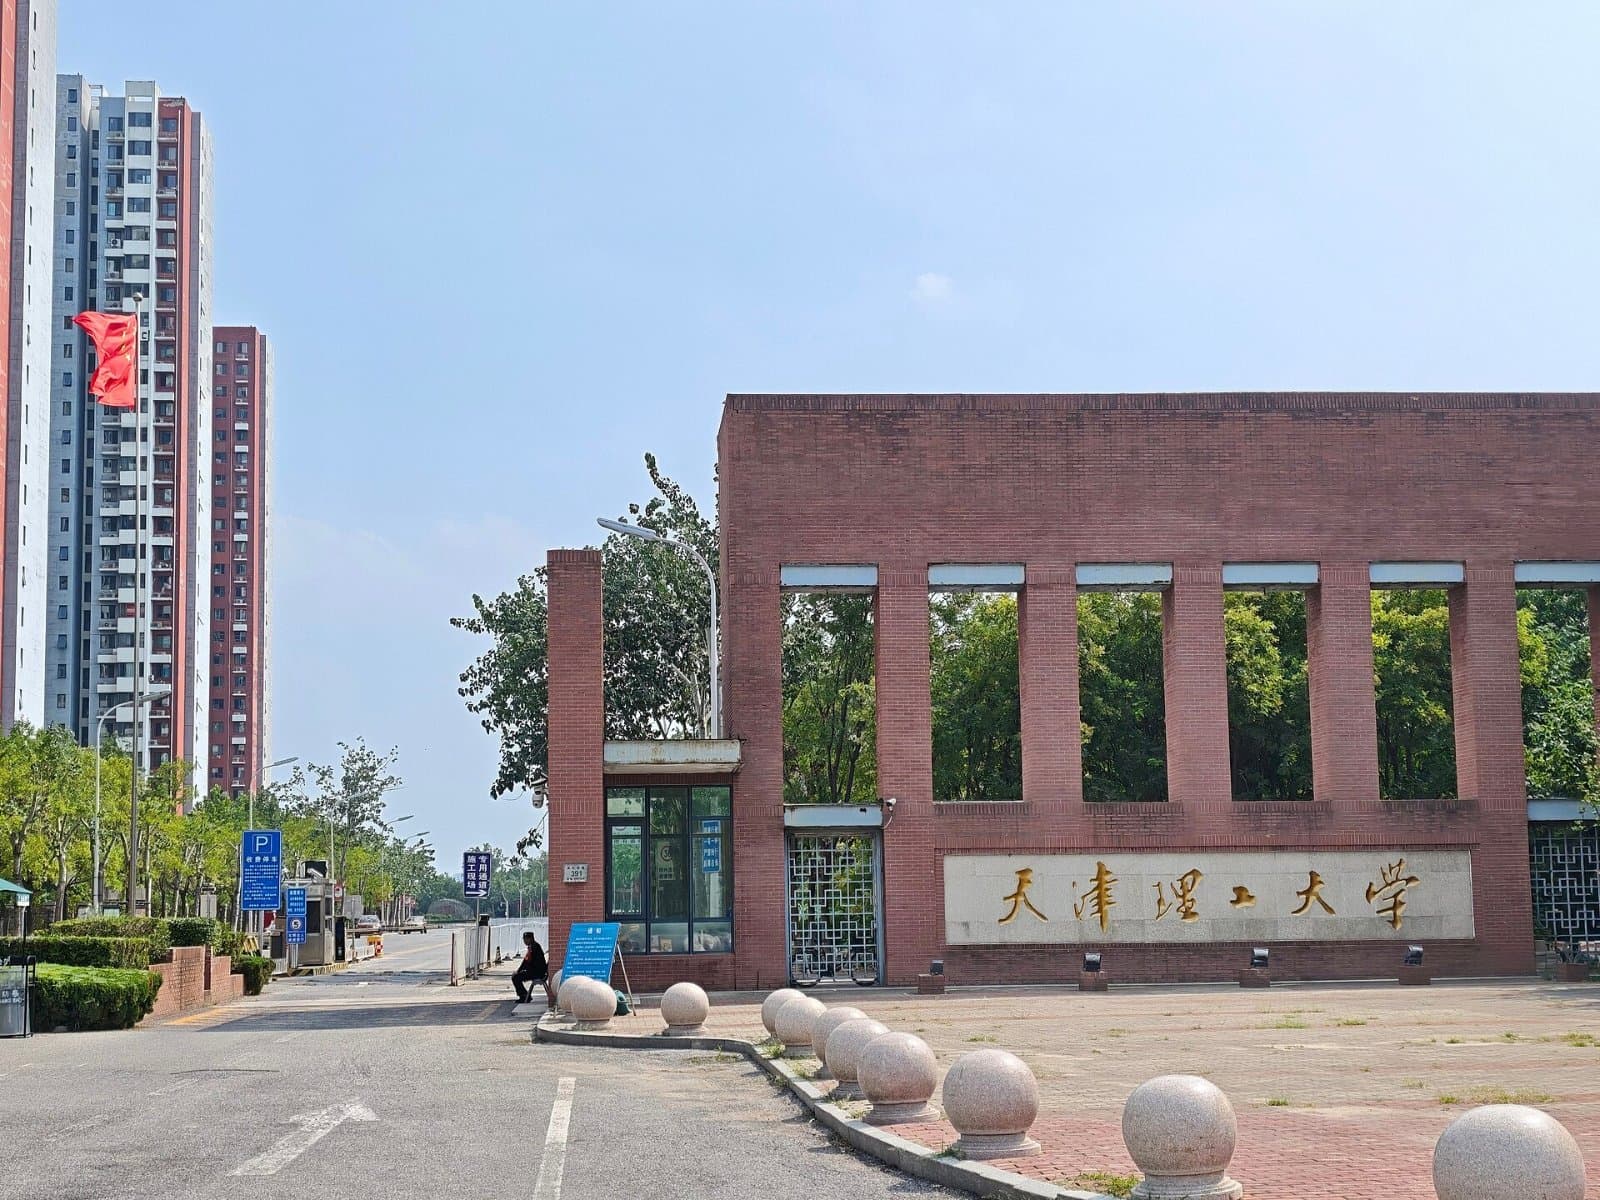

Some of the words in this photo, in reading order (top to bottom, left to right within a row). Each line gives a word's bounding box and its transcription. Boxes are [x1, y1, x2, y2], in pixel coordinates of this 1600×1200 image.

[256, 836, 268, 852] P
[467, 855, 476, 888] 施工现场
[479, 855, 488, 888] 专用通道
[998, 857, 1420, 934] 天津理工大学
